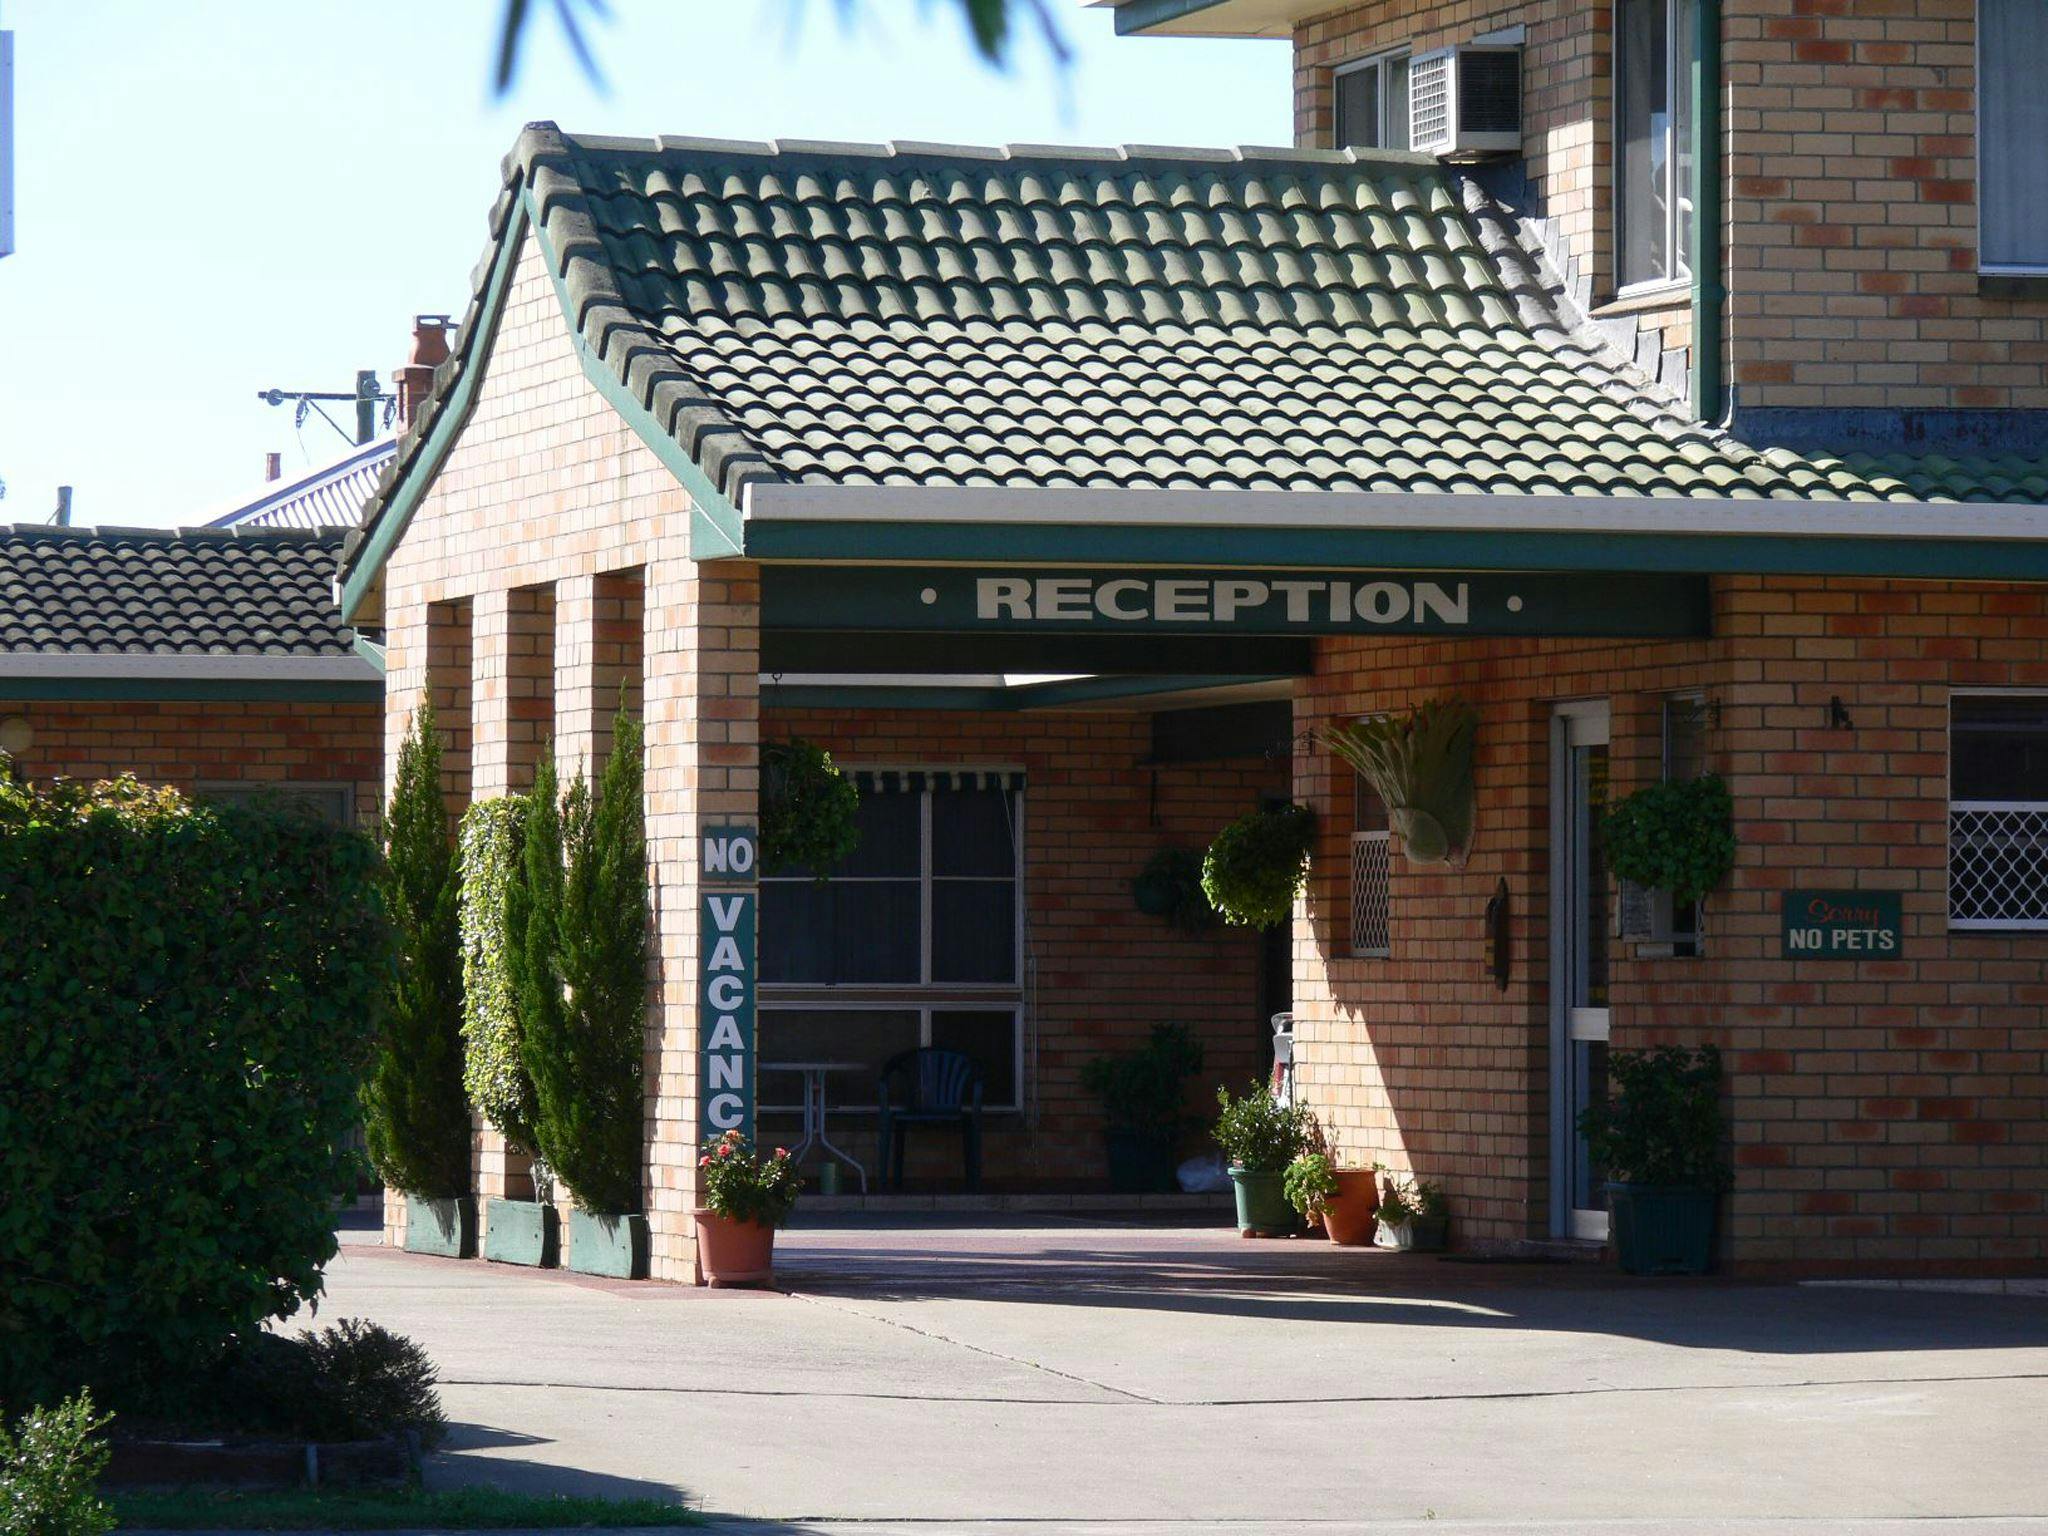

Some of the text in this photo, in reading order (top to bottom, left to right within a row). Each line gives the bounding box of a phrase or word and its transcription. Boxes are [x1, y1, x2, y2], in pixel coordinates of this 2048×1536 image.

[976, 577, 1470, 625] RECEPTION
[703, 836, 754, 873] NO
[1789, 928, 1895, 950] NO PETS
[707, 896, 745, 1141] VACANC
